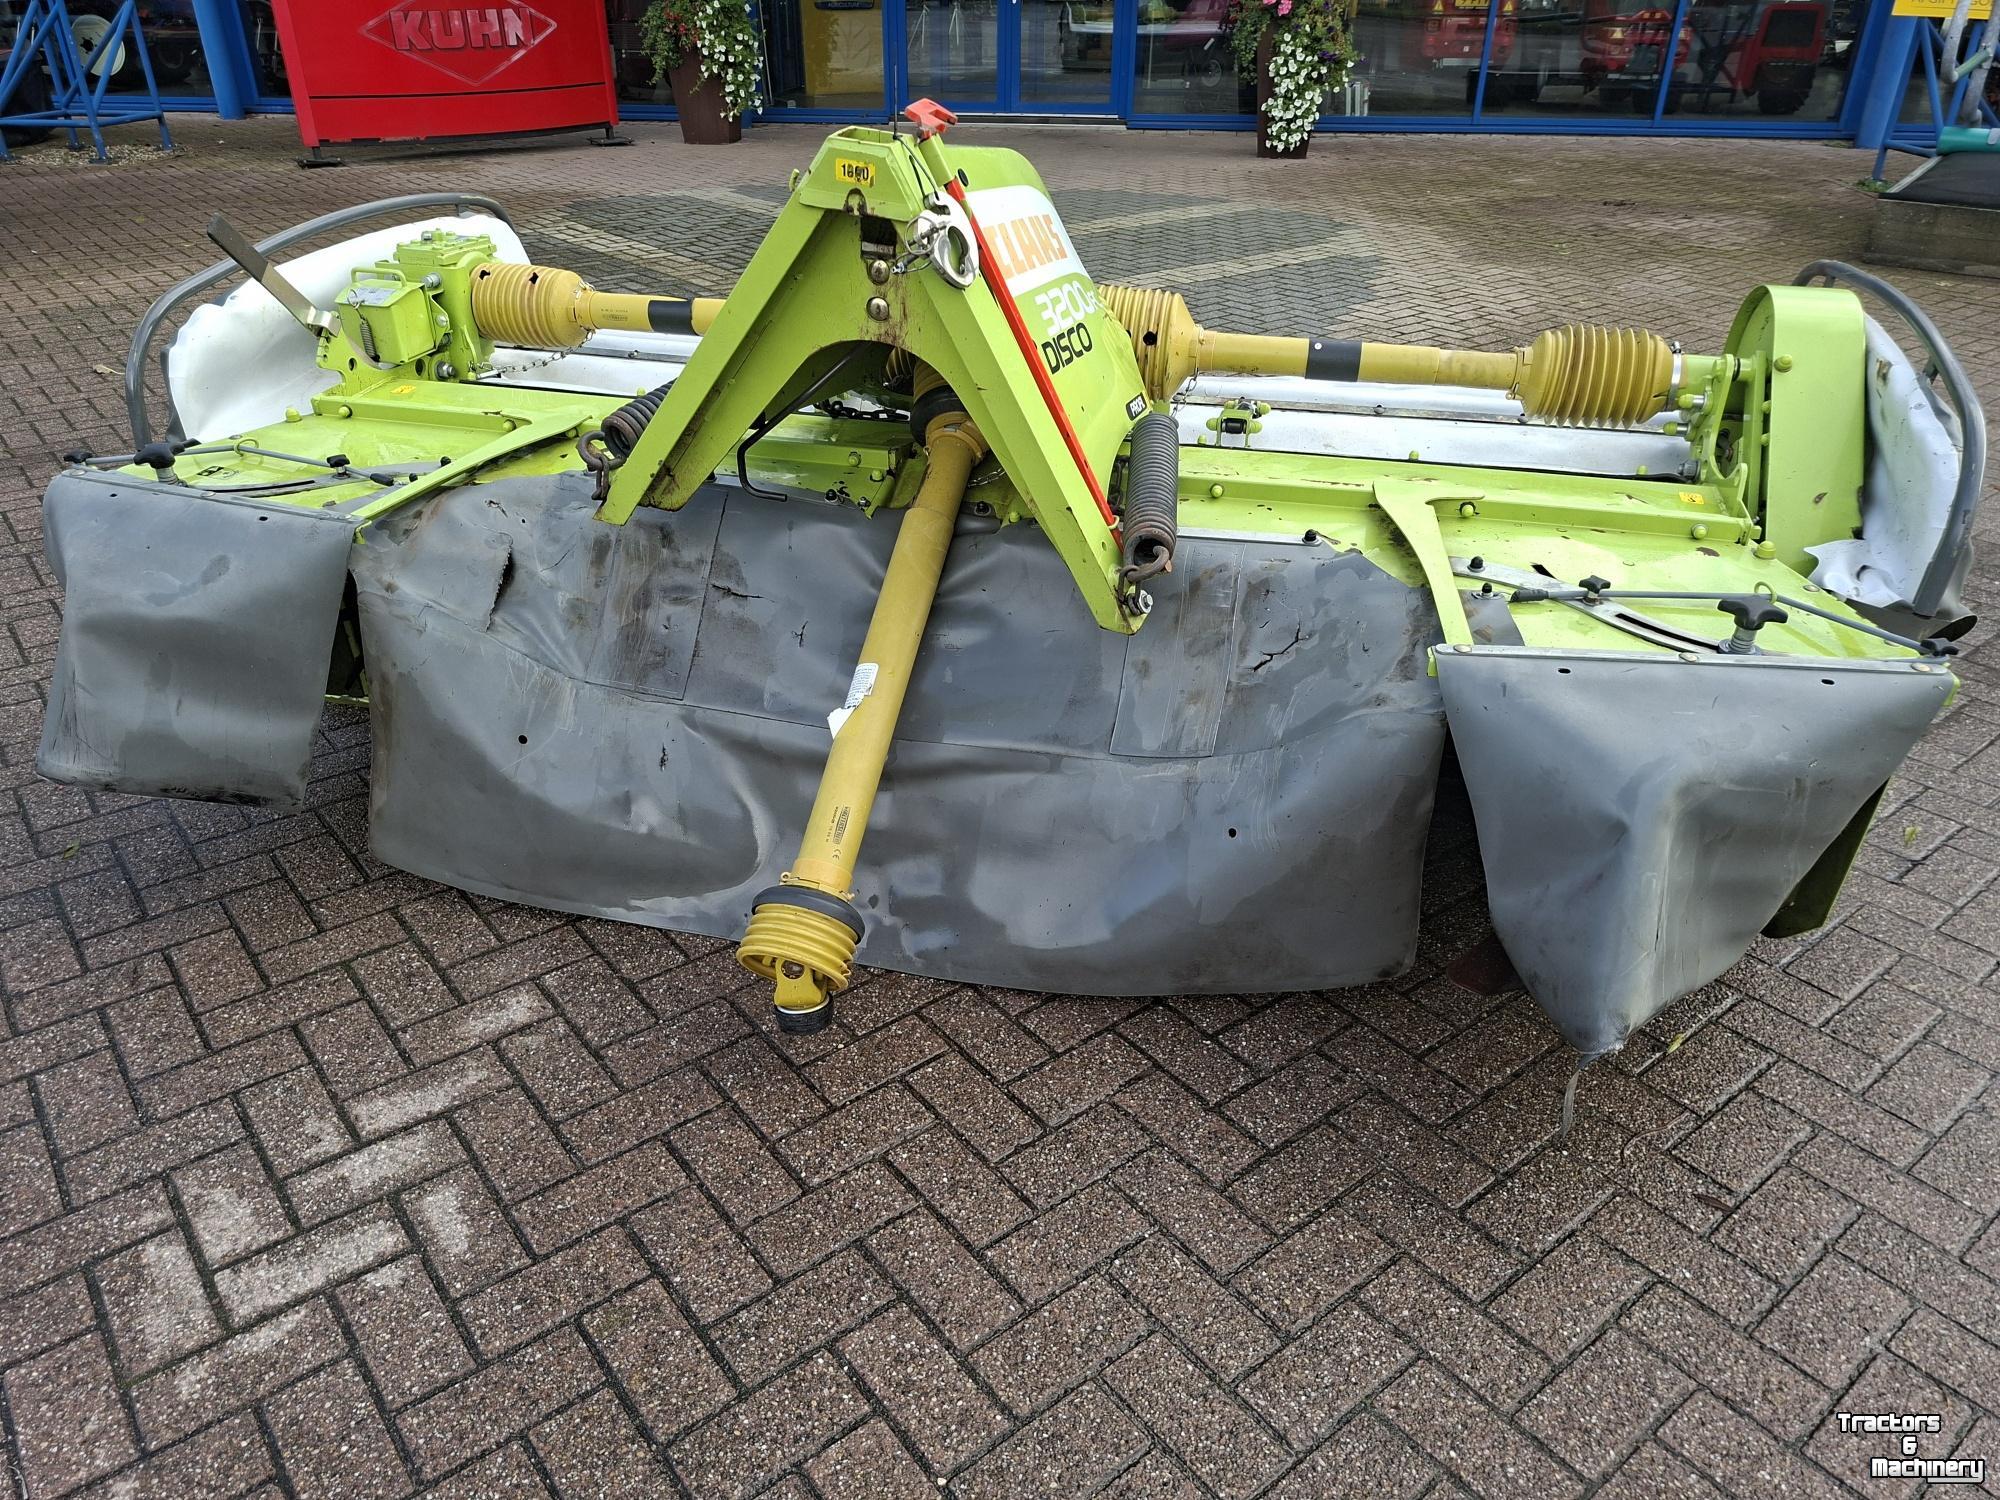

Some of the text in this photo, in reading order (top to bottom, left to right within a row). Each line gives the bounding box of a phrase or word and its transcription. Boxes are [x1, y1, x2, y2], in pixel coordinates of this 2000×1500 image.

[390, 8, 534, 50] KUHN
[983, 214, 1068, 279] CLAAS
[1034, 281, 1097, 336] 3200
[1041, 322, 1093, 375] DISCO
